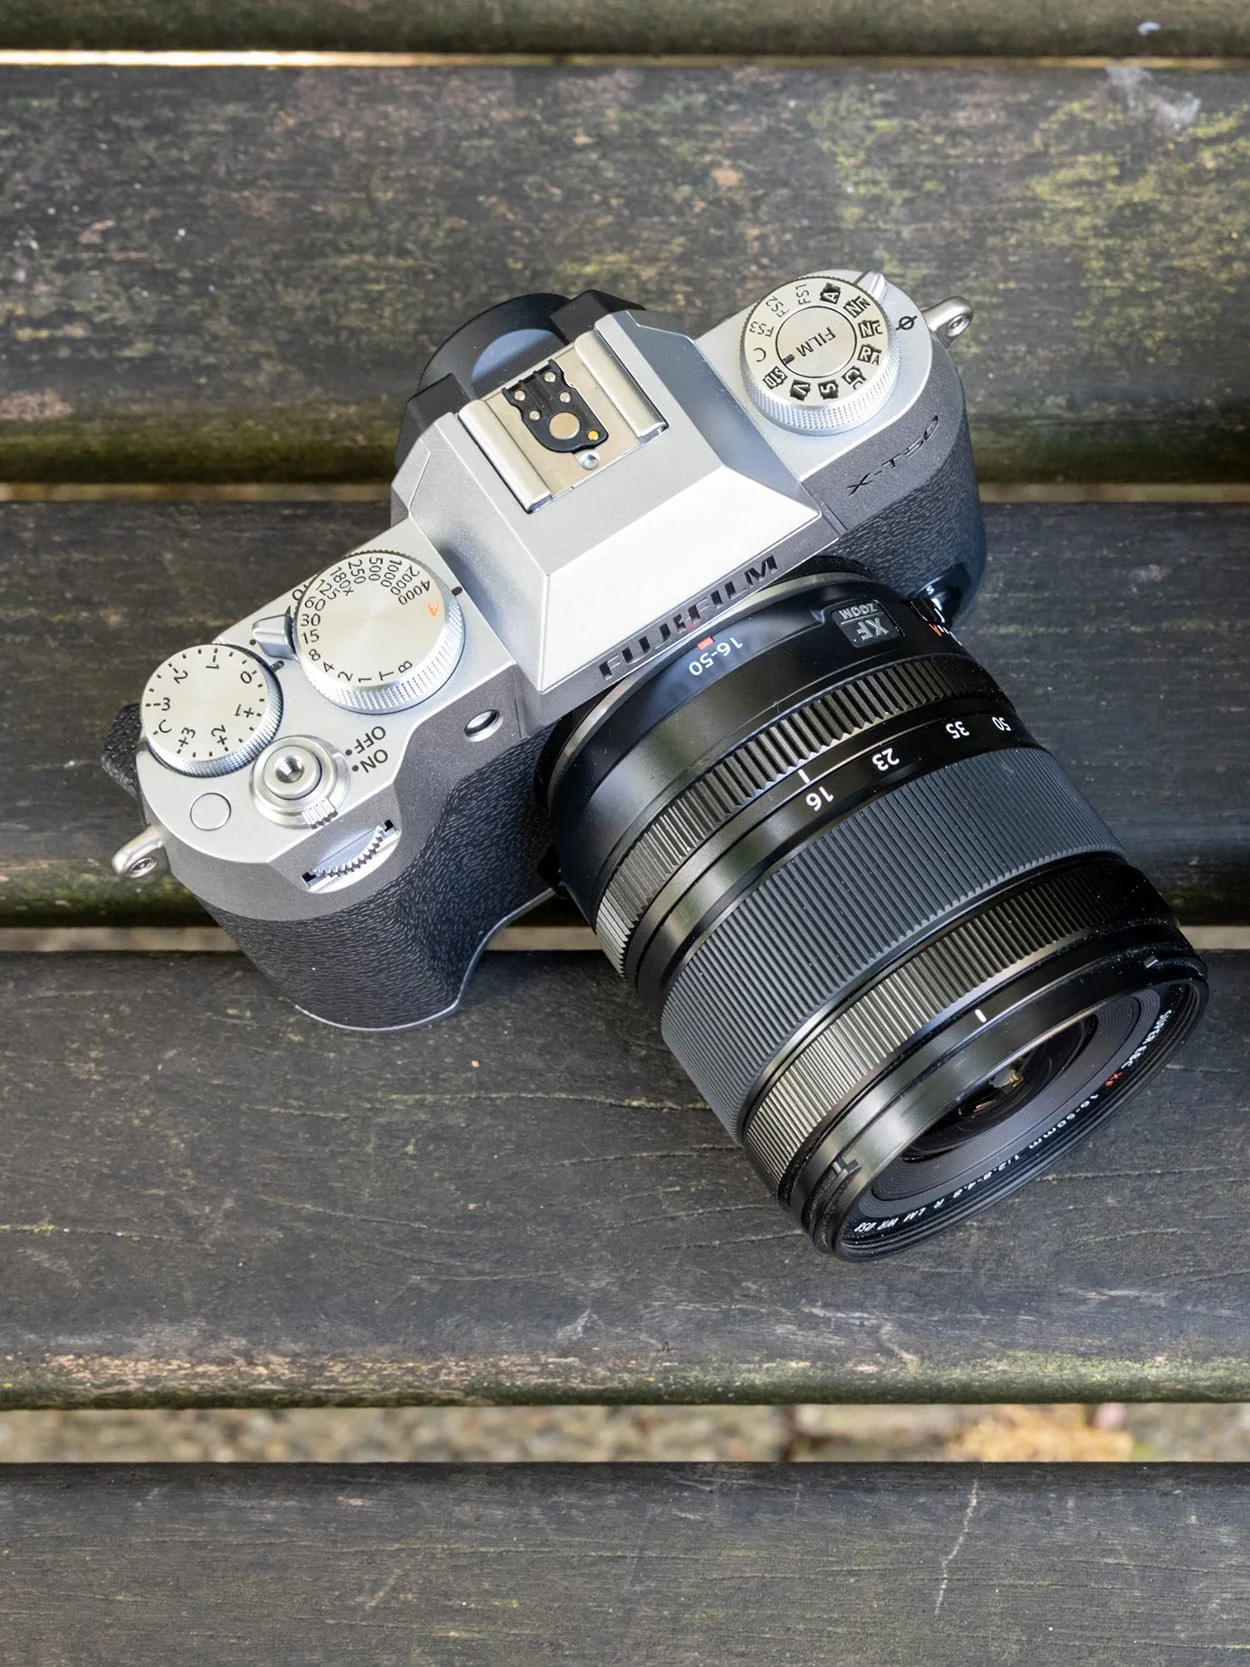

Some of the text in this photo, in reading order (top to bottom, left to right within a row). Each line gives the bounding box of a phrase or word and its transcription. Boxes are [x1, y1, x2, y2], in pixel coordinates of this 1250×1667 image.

[795, 284, 811, 305] FS1
[765, 295, 789, 318] FS2
[749, 321, 775, 337] FS3
[795, 326, 836, 357] FILM
[753, 347, 767, 363] C
[845, 414, 939, 498] X-T50
[348, 559, 366, 584] 250
[368, 557, 383, 581] 500
[380, 559, 403, 588] 1000
[315, 579, 341, 600] 125
[330, 566, 354, 597] 180x
[390, 565, 420, 595] 2000
[398, 580, 430, 605] 4000
[304, 596, 326, 612] 60
[427, 603, 440, 617] A
[838, 603, 878, 619] ZOOM
[300, 613, 321, 627] 30
[598, 553, 779, 681] FUJIFILM
[301, 629, 320, 645] 15
[856, 617, 889, 640] XF
[308, 648, 321, 661] 8
[688, 636, 744, 677] 16-50
[240, 671, 252, 684] 0
[322, 661, 335, 673] 4
[337, 671, 353, 682] 2
[378, 671, 394, 682] T
[398, 660, 413, 674] B
[234, 703, 254, 718] +1
[158, 719, 172, 734] C
[945, 721, 971, 739] 35
[991, 716, 1012, 731] 50
[178, 726, 196, 747] +3
[210, 724, 228, 745] +2
[353, 725, 387, 754] OFF
[360, 748, 388, 774] ON
[871, 747, 900, 772] 23
[805, 786, 834, 812] 16
